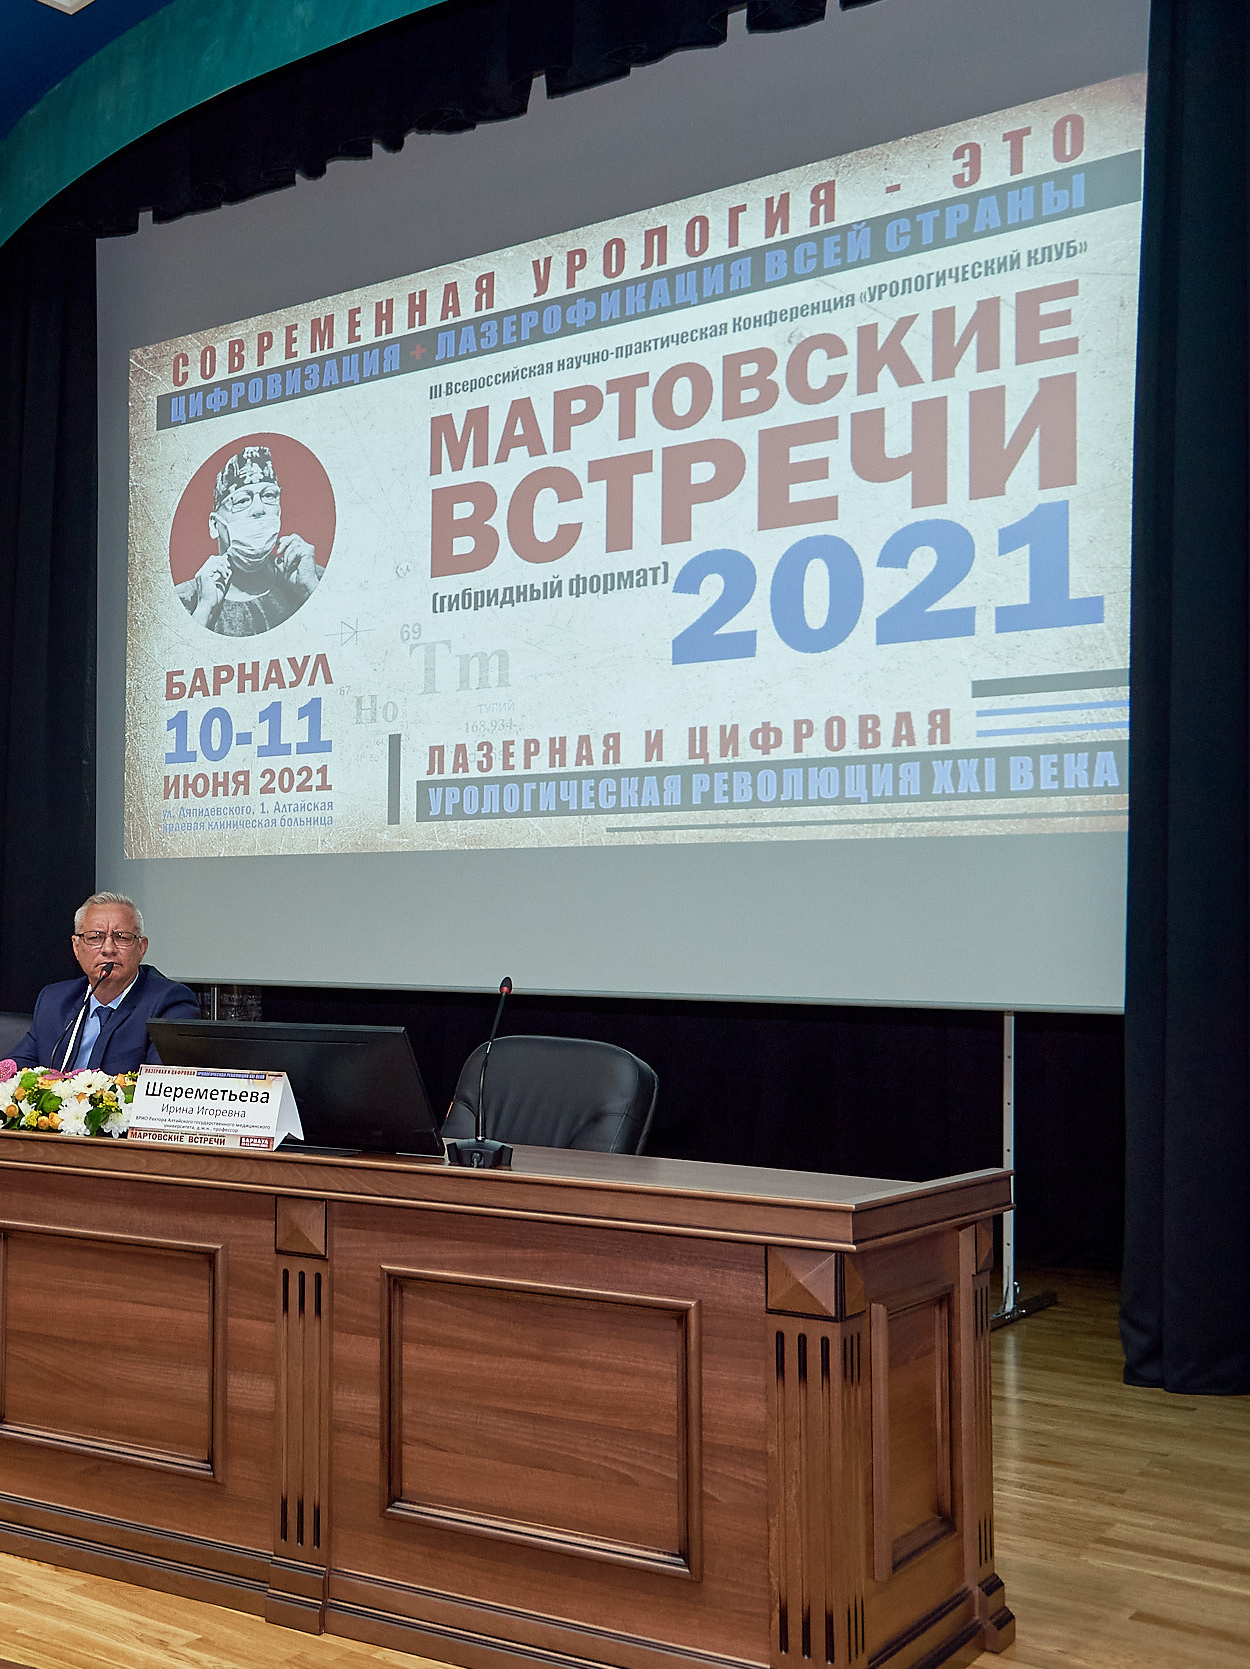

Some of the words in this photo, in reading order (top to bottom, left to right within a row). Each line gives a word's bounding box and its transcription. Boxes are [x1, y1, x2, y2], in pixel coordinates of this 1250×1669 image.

[172, 271, 496, 387] СОВРЕМЕННАЯ
[531, 180, 836, 297] УРОЛОГИЯ
[952, 113, 1085, 189] ЭТО
[170, 342, 401, 424] ЦИФРОВИЗАЦИЯ
[435, 257, 752, 361] ЛАЗЕРОФИКАЦИЯ
[764, 220, 872, 283] ВСЕЙ
[885, 173, 1086, 253] СТРАНЫ
[445, 361, 554, 397] Всероссийская
[557, 319, 728, 372] научно-практическая
[732, 292, 855, 334] Конференция
[859, 249, 1021, 306] «УРОЛОГИЧЕСКИЙ
[1026, 238, 1089, 270] КЛУБ»
[429, 278, 1079, 476] МАРТОВСКИЕ
[430, 371, 1078, 578] ВСТРЕЧИ
[432, 574, 563, 614] (гибридный
[568, 561, 670, 598] формат)
[671, 500, 1105, 665] 2021
[400, 622, 423, 642] 69
[165, 653, 334, 701] БАРНАУЛ
[409, 638, 512, 696] Tm
[164, 697, 333, 765] 10-11
[353, 694, 399, 725] Ho
[426, 731, 621, 776] ЛАЗЕРНАЯ
[644, 728, 664, 763] И
[688, 707, 951, 764] ЦИФРОВАЯ
[163, 769, 251, 800] ИЮНЯ
[259, 764, 333, 795] 2021
[273, 800, 334, 813] Алтайская
[428, 774, 682, 816] УРОЛОГИЧЕСКАЯ
[692, 761, 921, 805] РЕВОЛЮЦИЯ
[932, 757, 996, 794] XXI
[1009, 751, 1120, 791] ВЕКА
[207, 817, 277, 831] клиническая
[279, 815, 334, 828] больница
[145, 1081, 270, 1104] Шереметьева
[161, 1103, 194, 1115] Ирина
[196, 1105, 247, 1119] Игоревна
[130, 1131, 185, 1143] МАРТОВСКИЕ
[188, 1135, 226, 1146] ВСТРЕЧИ
